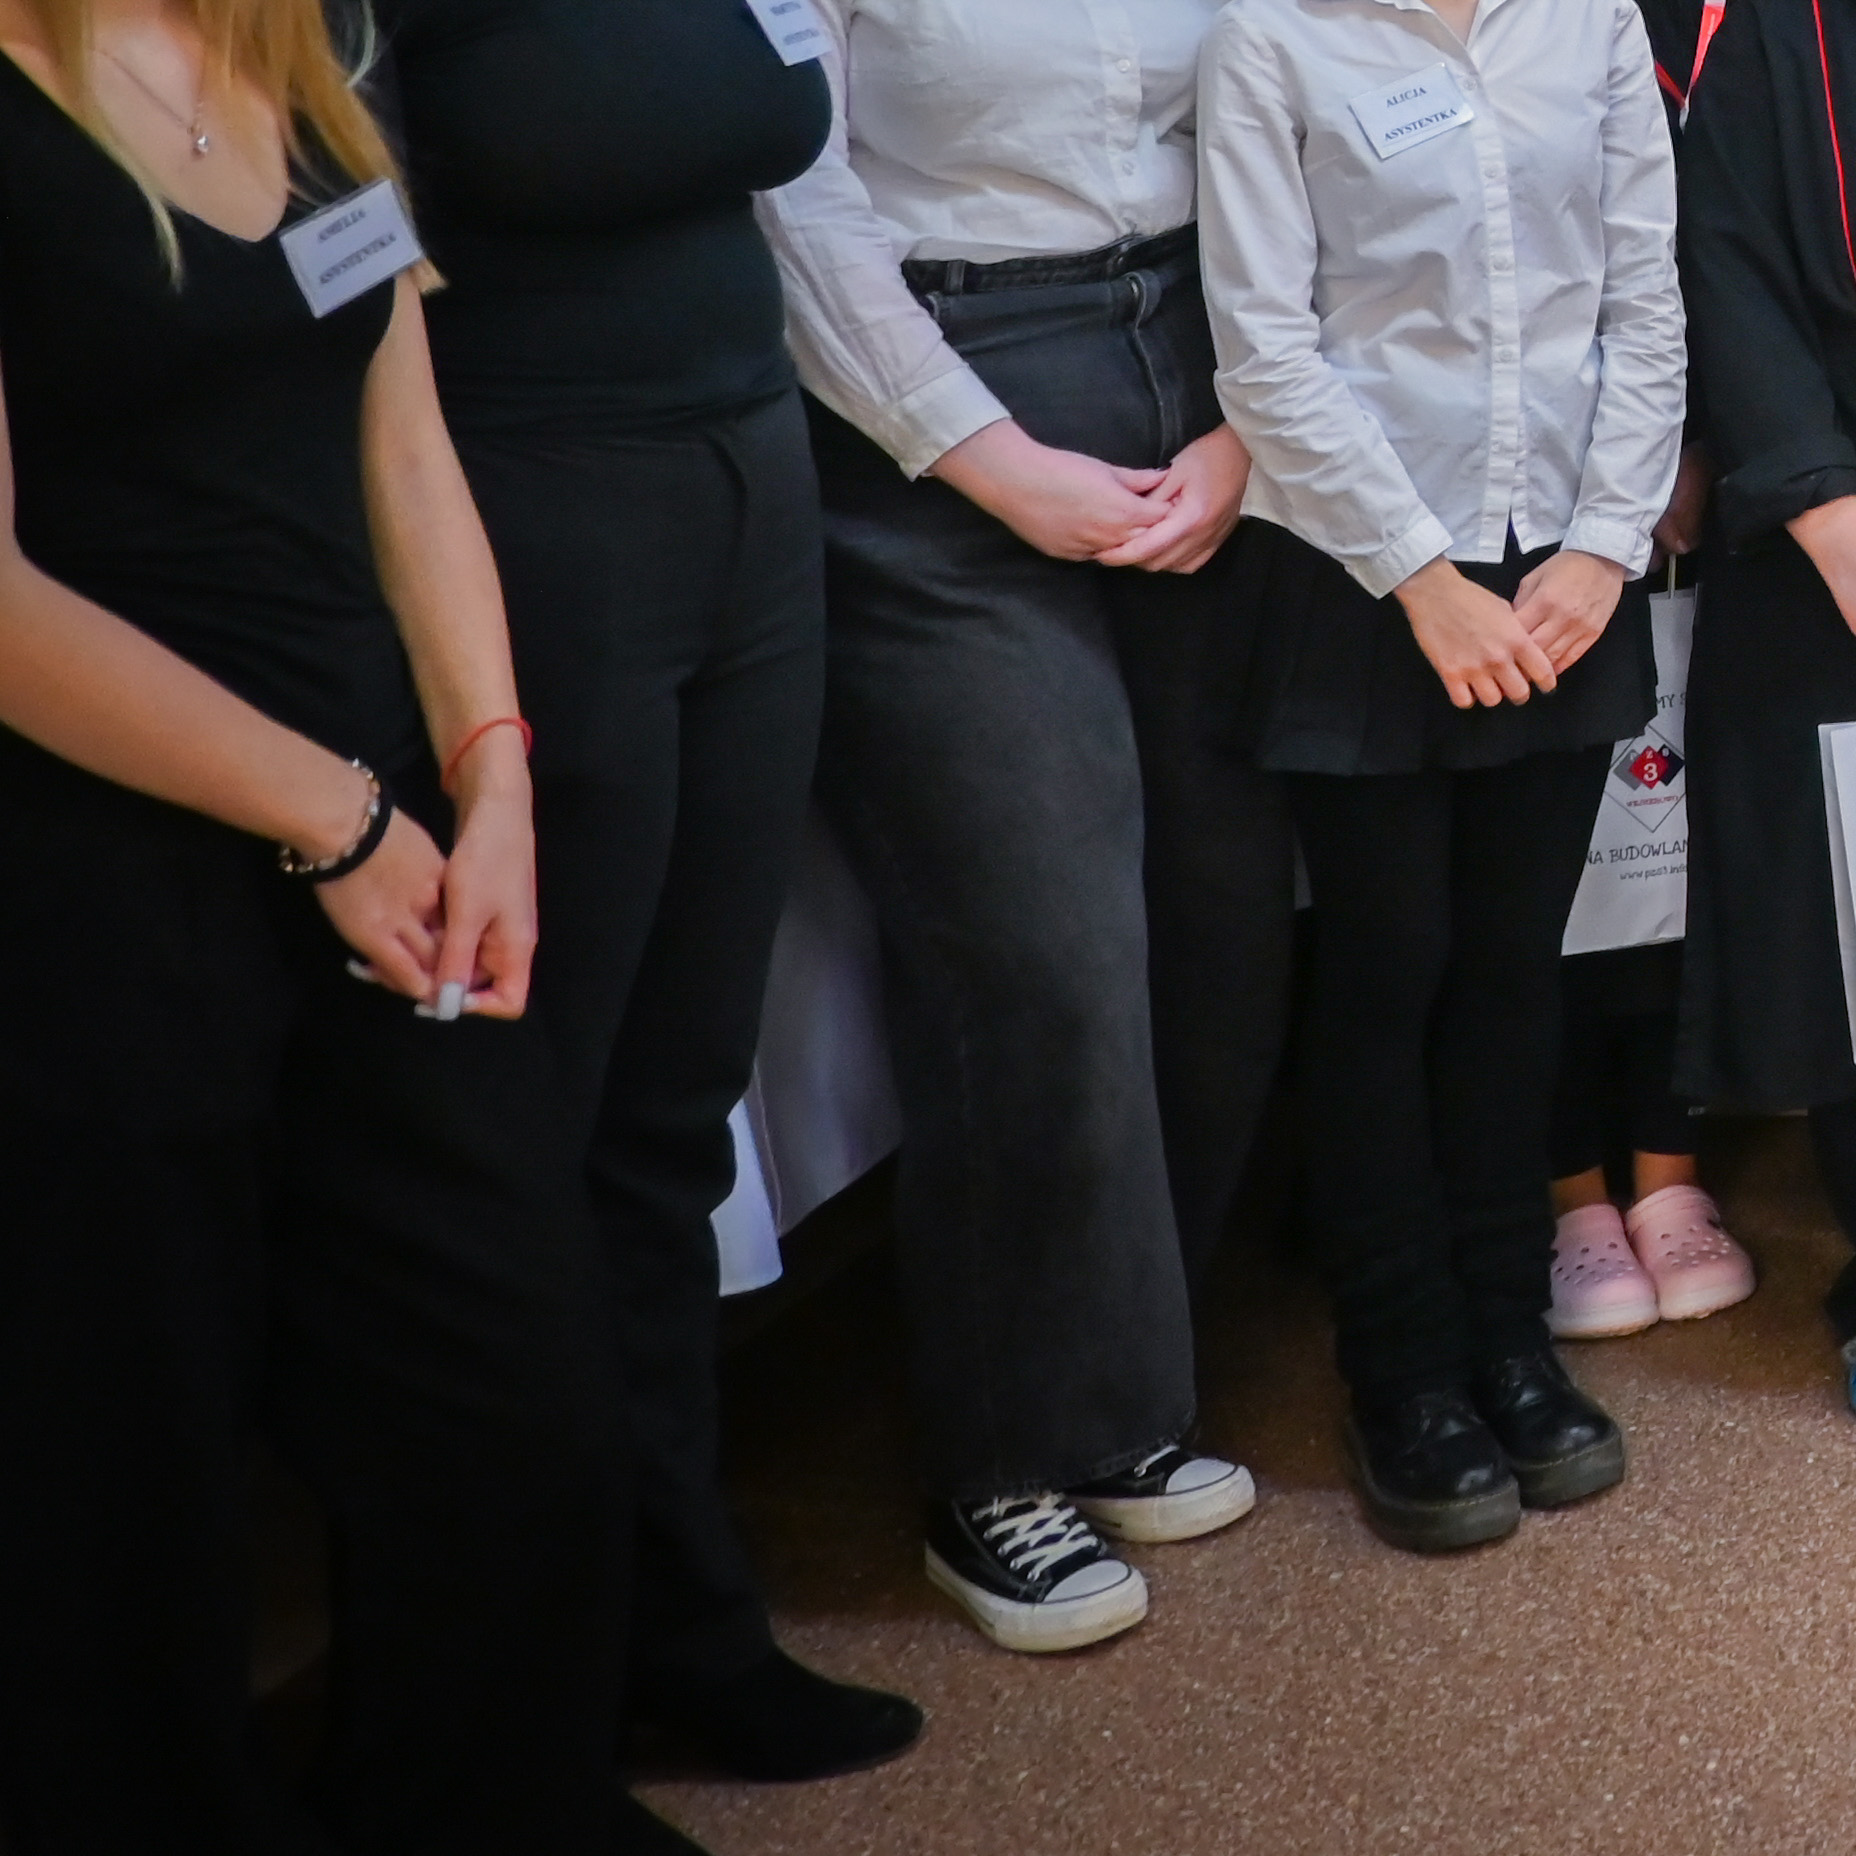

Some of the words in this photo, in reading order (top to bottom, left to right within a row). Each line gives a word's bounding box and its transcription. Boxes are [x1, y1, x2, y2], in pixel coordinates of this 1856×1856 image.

[1386, 86, 1427, 108] ALICJA
[1384, 108, 1458, 141] ASYSTENTKA
[1643, 762, 1658, 781] 3
